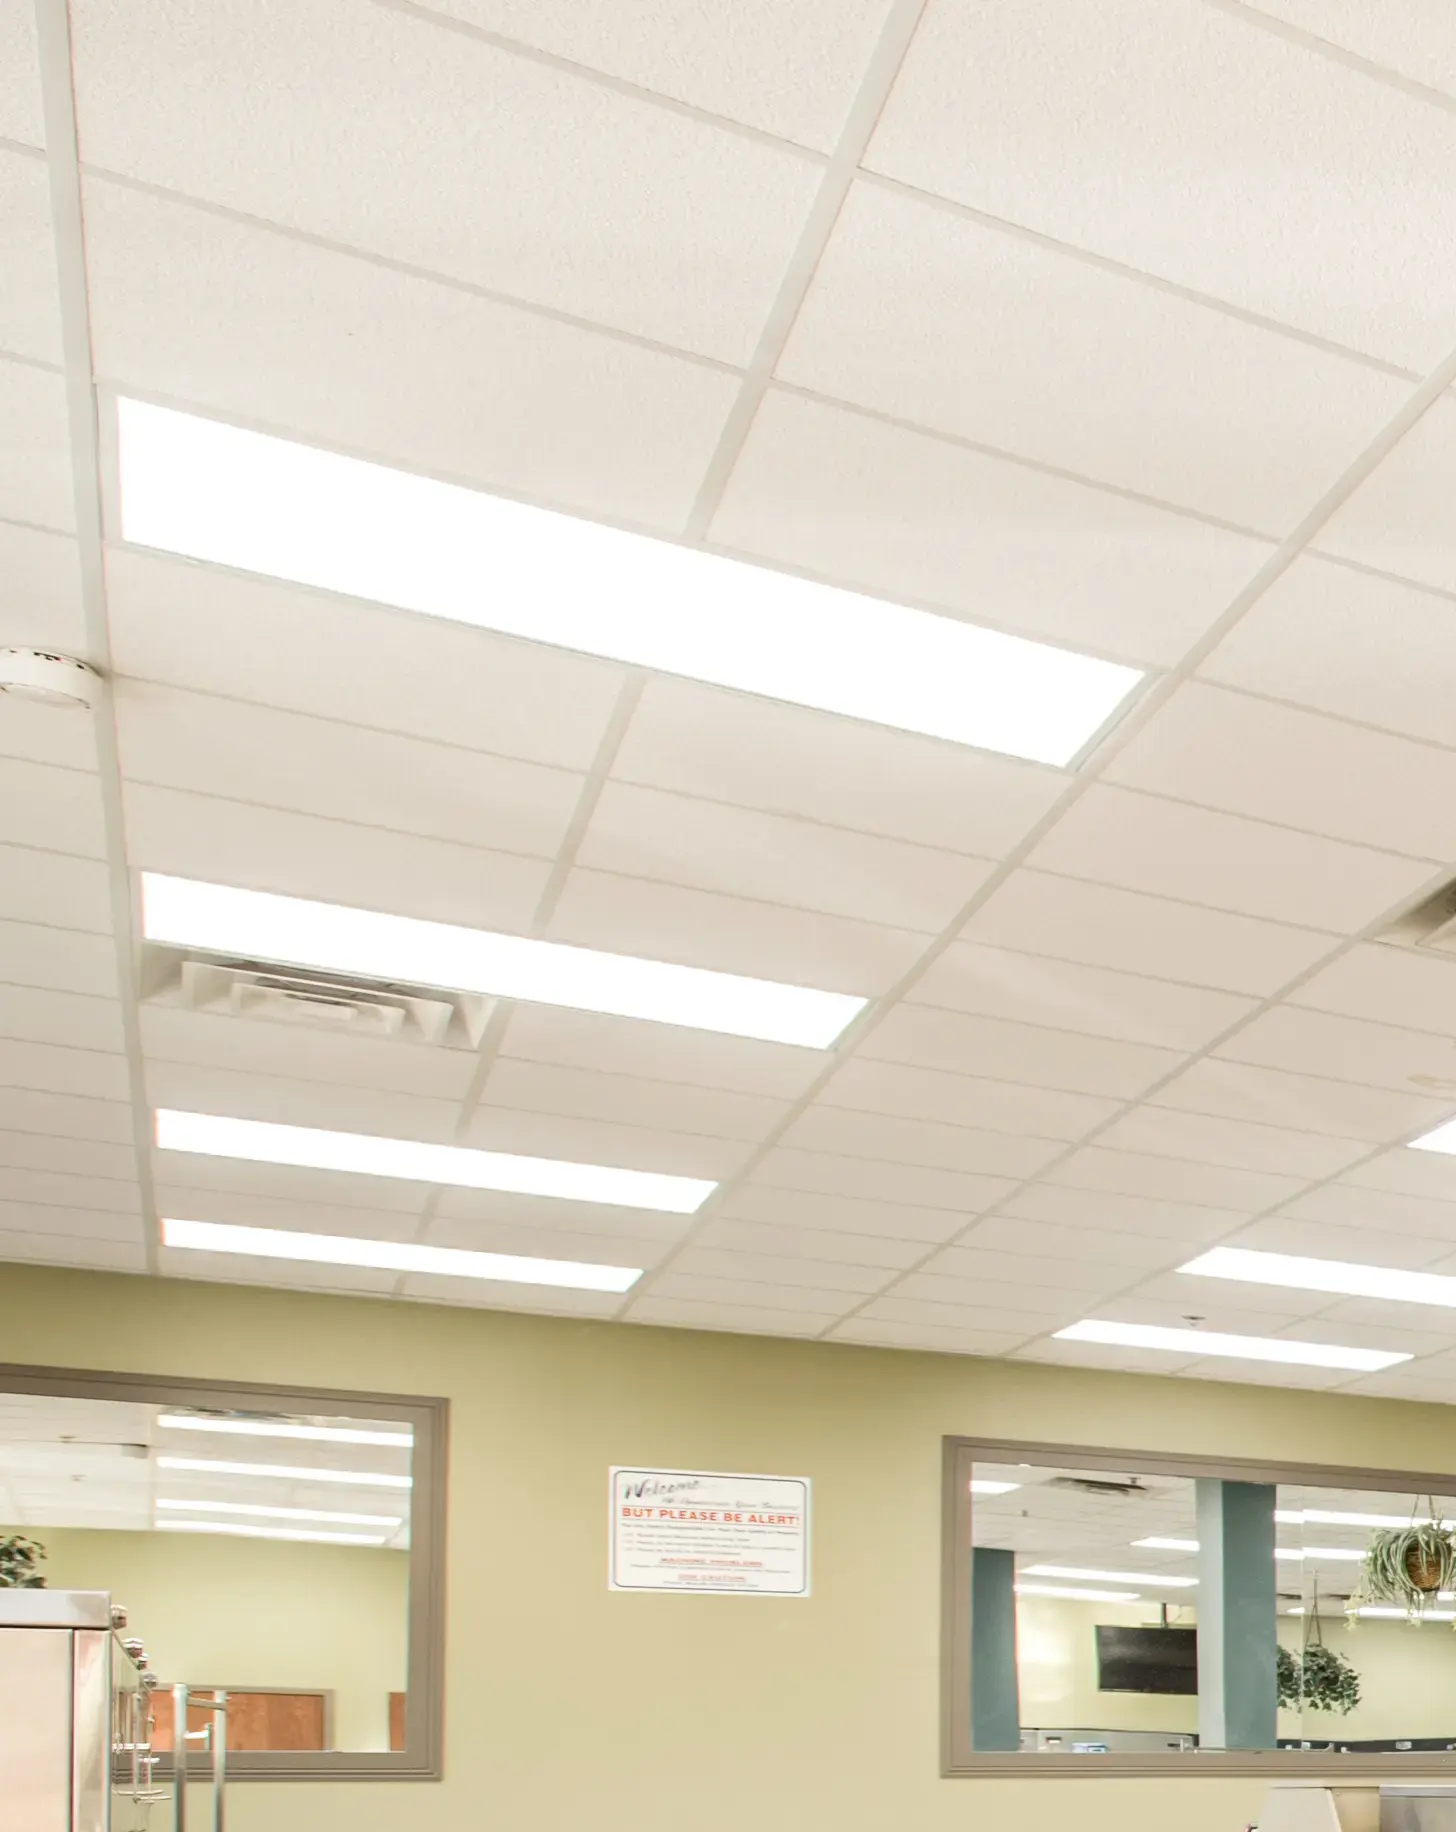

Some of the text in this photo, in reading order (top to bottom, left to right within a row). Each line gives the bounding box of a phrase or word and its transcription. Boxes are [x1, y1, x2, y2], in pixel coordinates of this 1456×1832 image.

[622, 1507, 800, 1525] BUT PLEASE BE ALERT!
